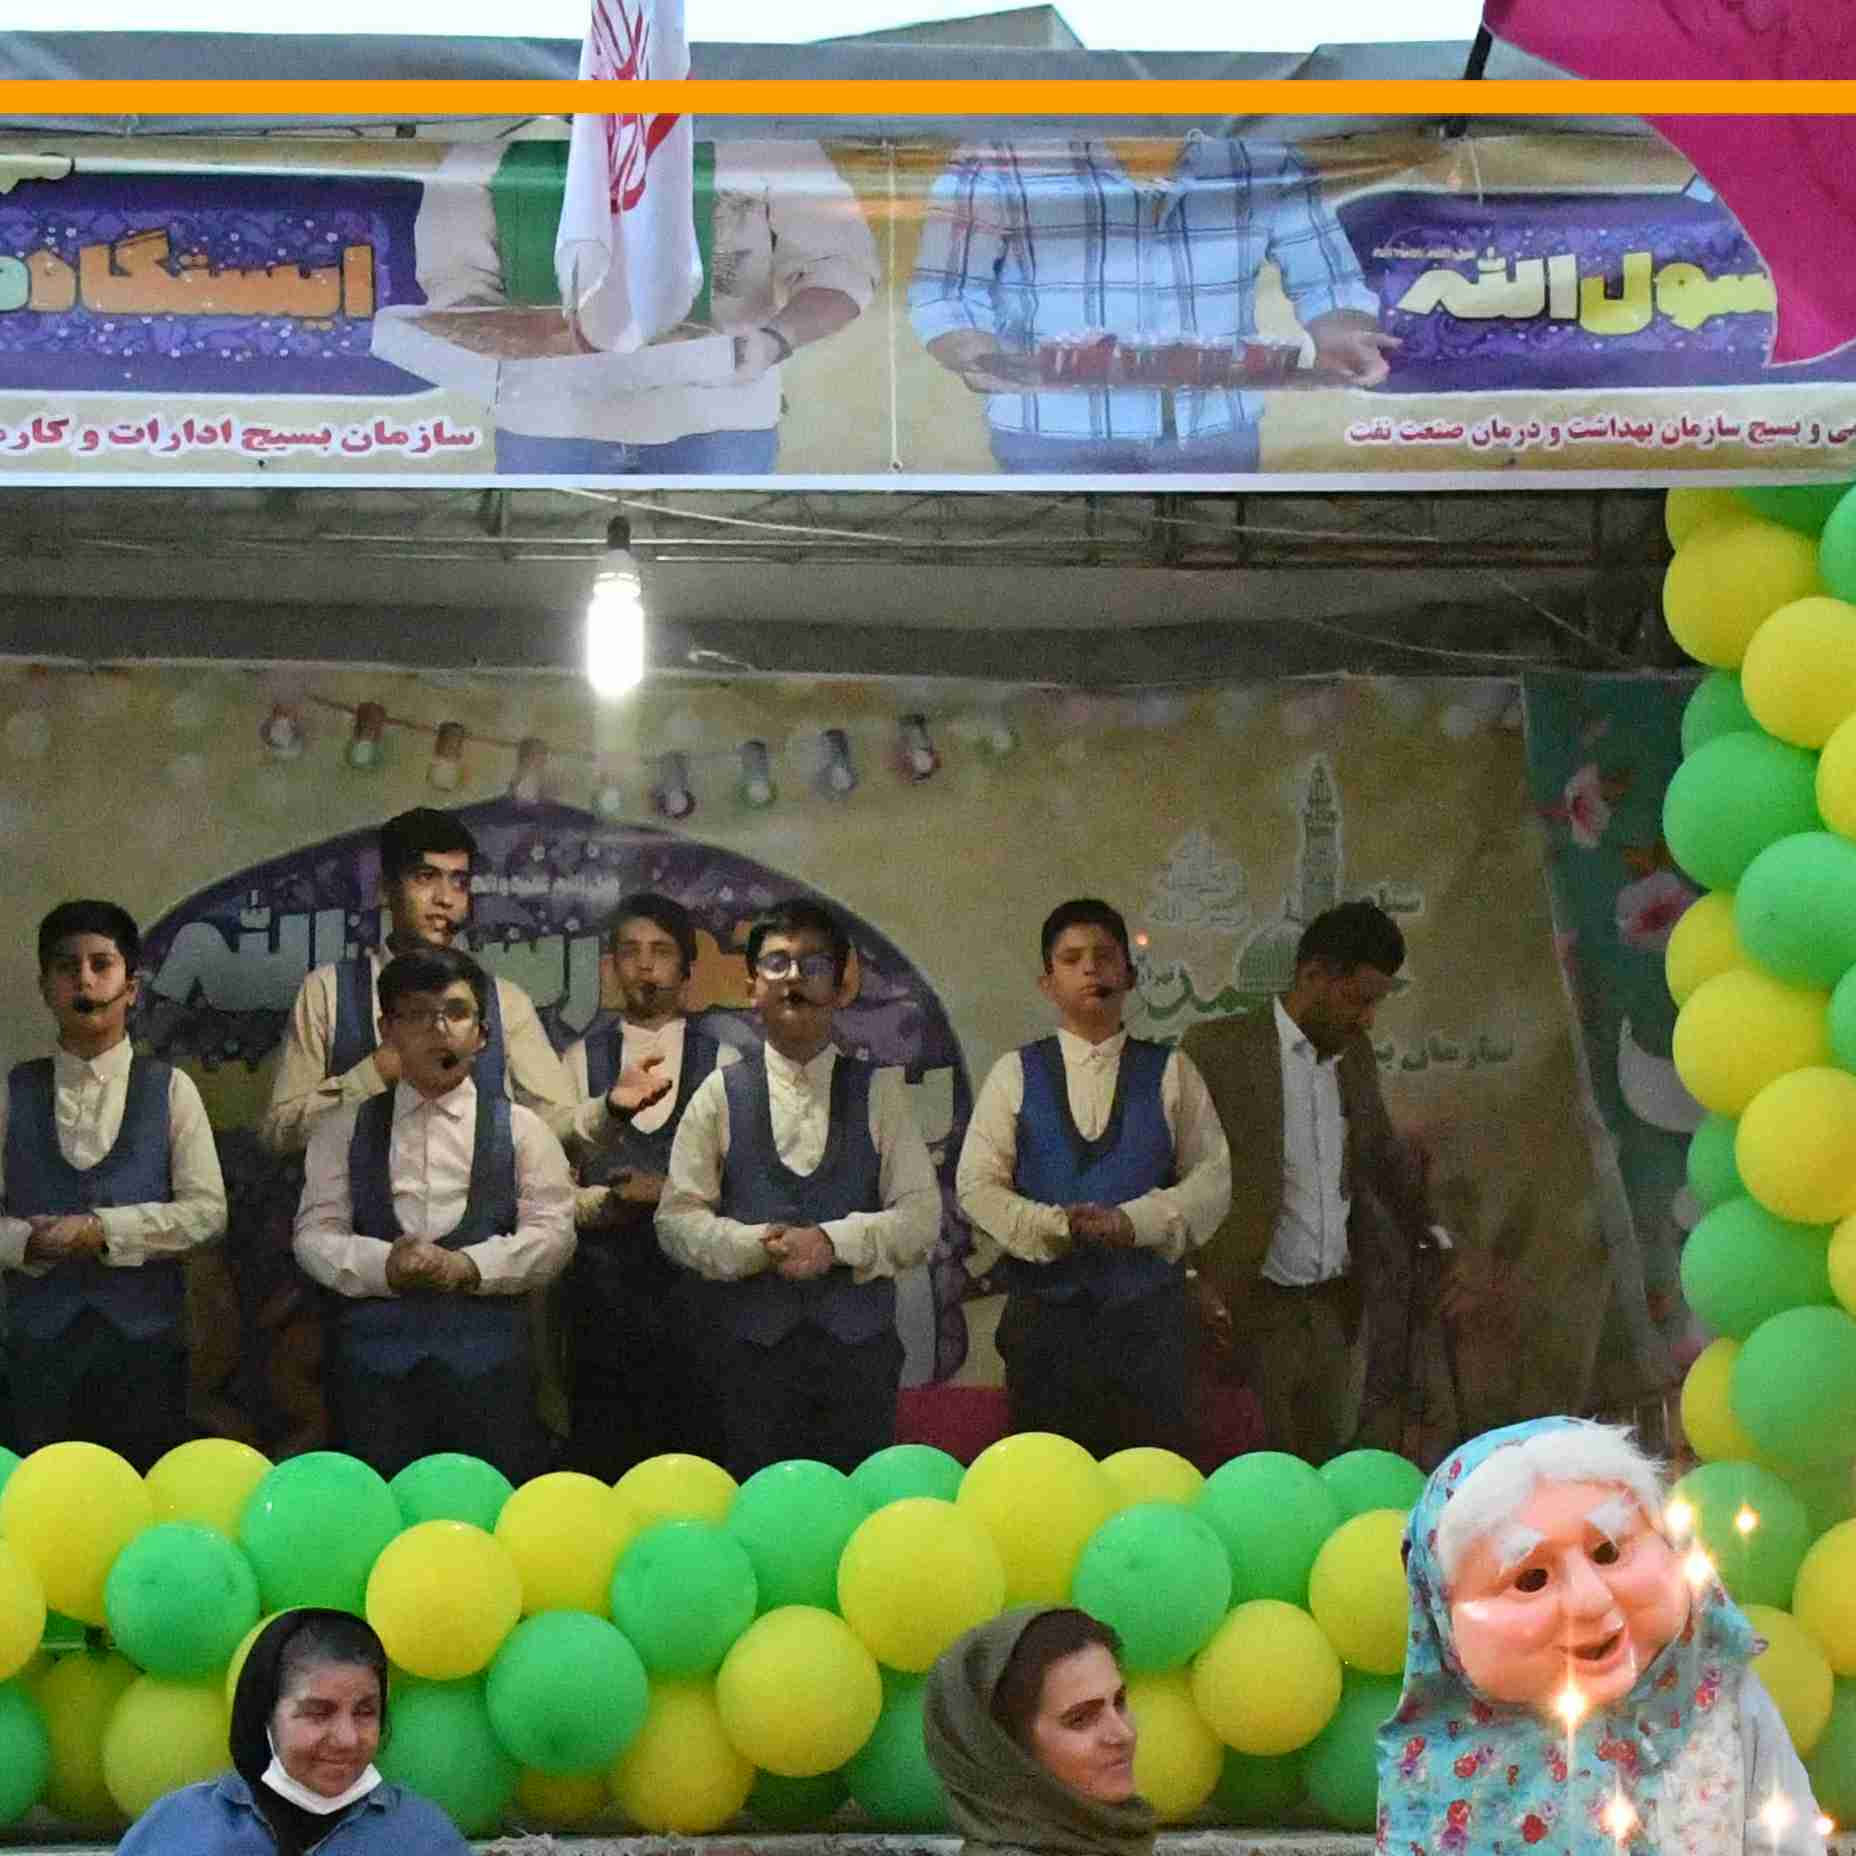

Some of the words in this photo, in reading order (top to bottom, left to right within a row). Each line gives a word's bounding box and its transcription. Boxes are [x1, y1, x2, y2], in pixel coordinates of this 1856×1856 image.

[28, 228, 374, 332] ایستگاه
[78, 427, 100, 452] و
[109, 418, 232, 453] ادارات
[241, 424, 332, 452] بسیج
[342, 420, 475, 453] سازمان
[1349, 417, 1392, 442] نفت
[1398, 419, 1465, 442] صنعت
[1471, 418, 1541, 446] درمان
[1549, 424, 1561, 447] و
[1568, 416, 1654, 445] بهداشت
[1662, 415, 1741, 445] سازمان
[1748, 418, 1801, 444] بسیج
[1810, 420, 1821, 445] و
